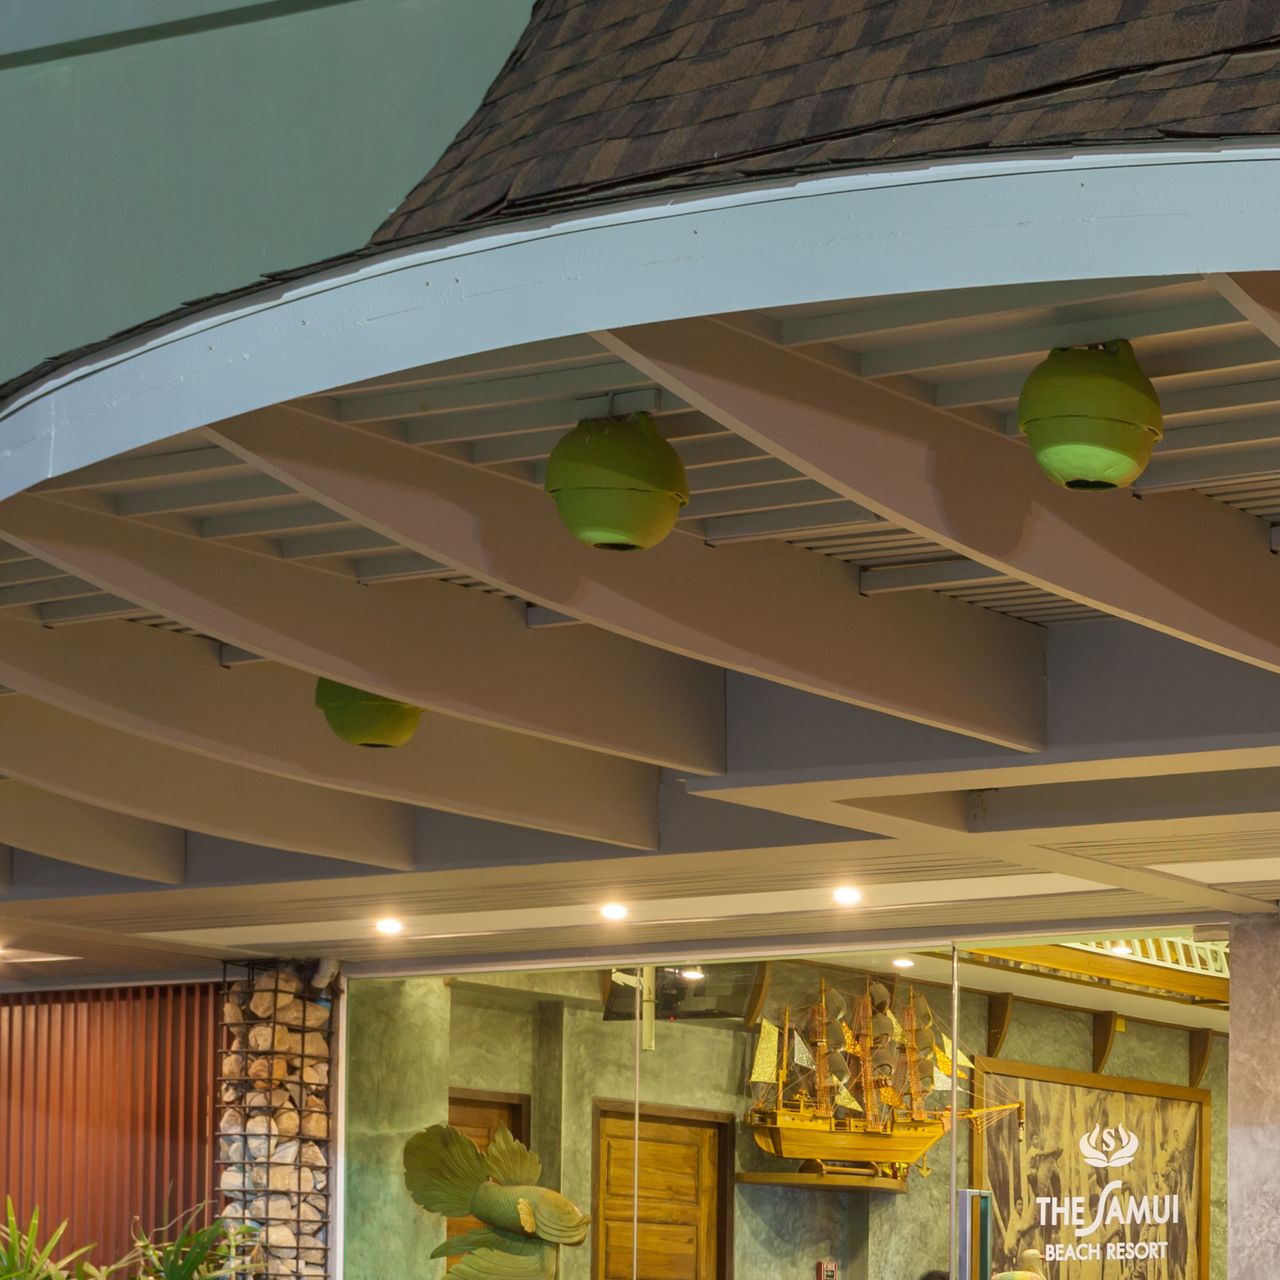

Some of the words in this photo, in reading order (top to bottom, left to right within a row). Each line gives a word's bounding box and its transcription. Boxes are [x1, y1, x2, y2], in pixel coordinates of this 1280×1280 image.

[1102, 1128, 1116, 1151] S
[1036, 1196, 1085, 1226] THE
[1074, 1180, 1179, 1237] SAMUI
[1045, 1243, 1100, 1262] BEACH
[1106, 1241, 1168, 1260] RESORT
